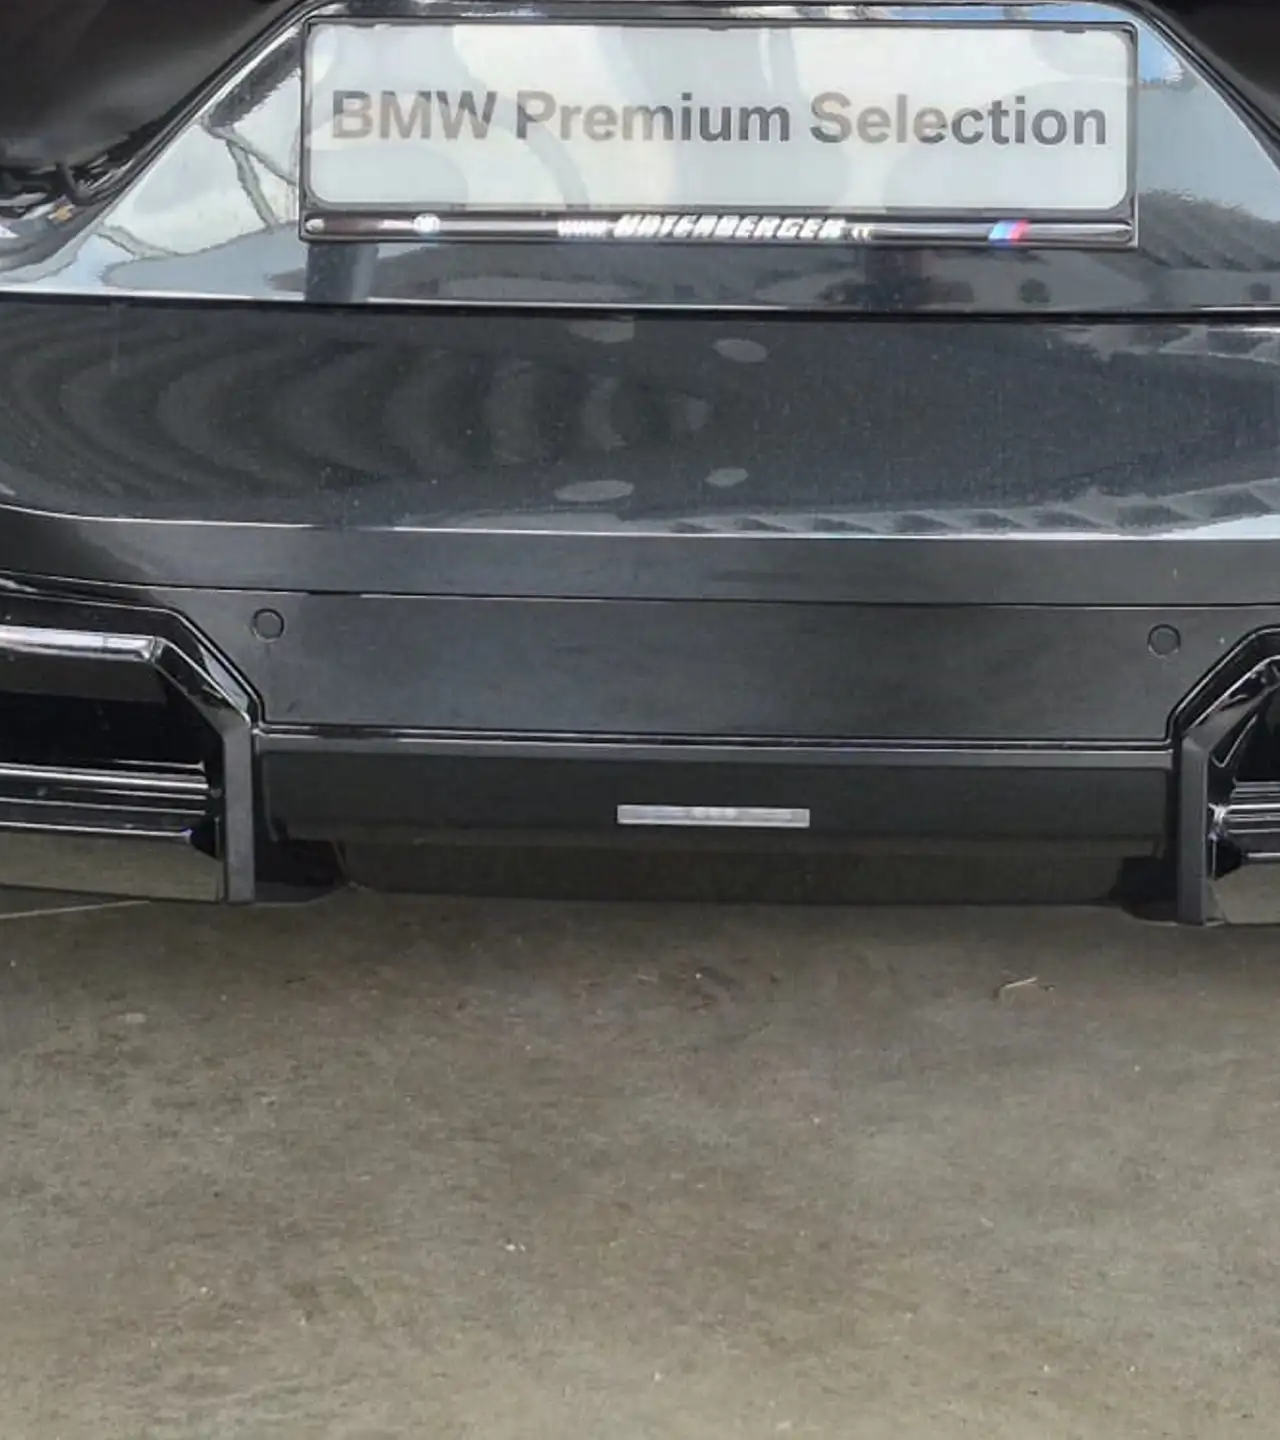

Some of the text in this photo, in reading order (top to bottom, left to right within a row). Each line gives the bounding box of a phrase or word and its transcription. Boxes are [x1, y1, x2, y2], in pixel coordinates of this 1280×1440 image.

[332, 90, 1107, 145] BMW Premium Selection
